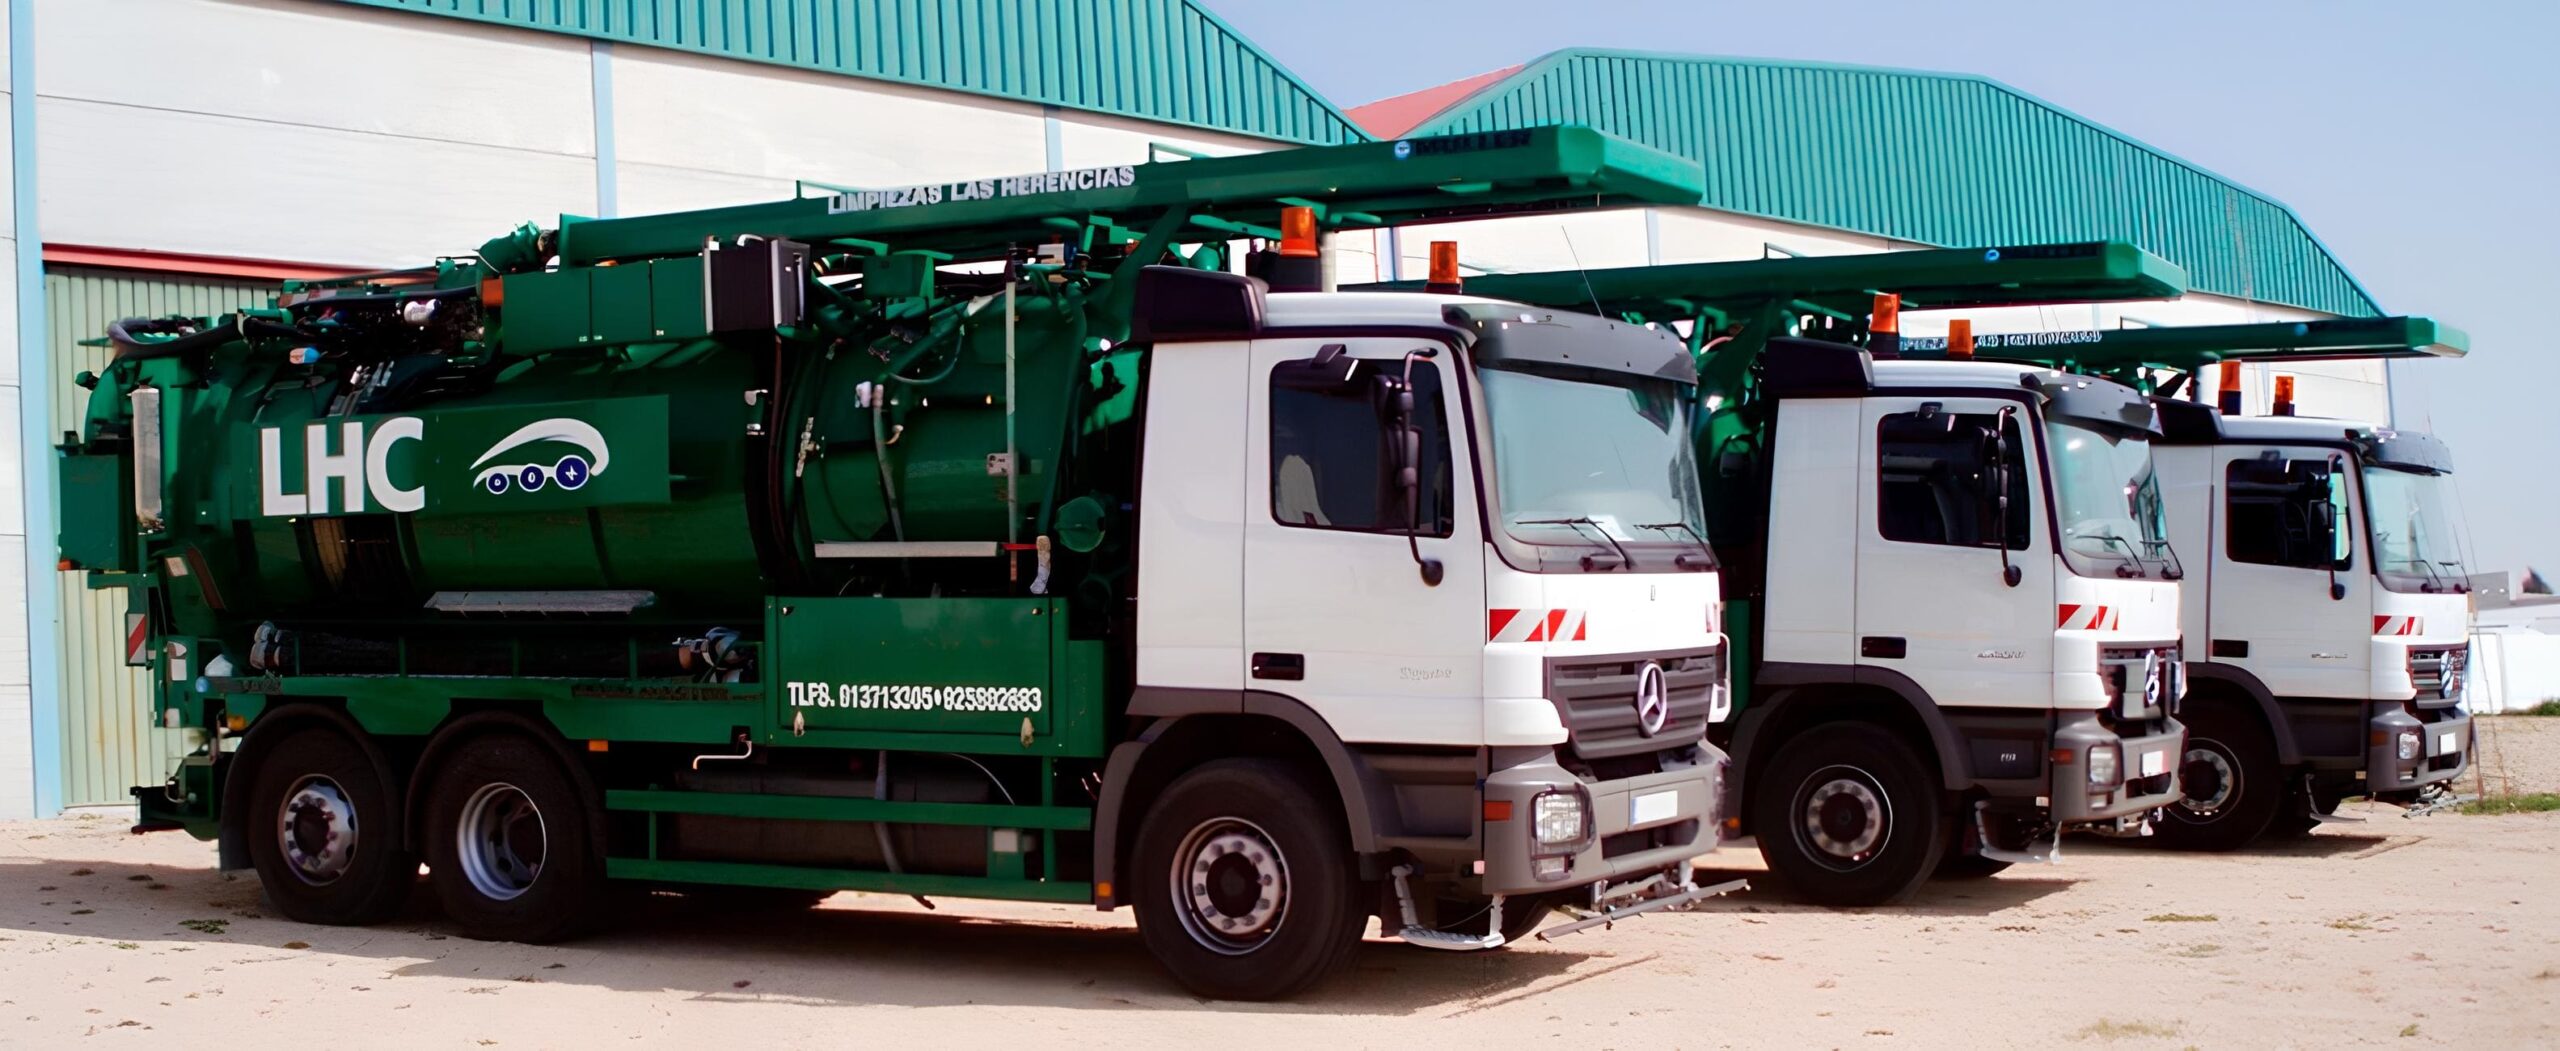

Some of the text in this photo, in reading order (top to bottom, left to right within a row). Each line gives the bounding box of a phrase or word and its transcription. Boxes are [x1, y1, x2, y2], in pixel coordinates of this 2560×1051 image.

[951, 179, 994, 201] LAS
[1001, 166, 1135, 197] HERENCIAS
[262, 416, 425, 516] LHC
